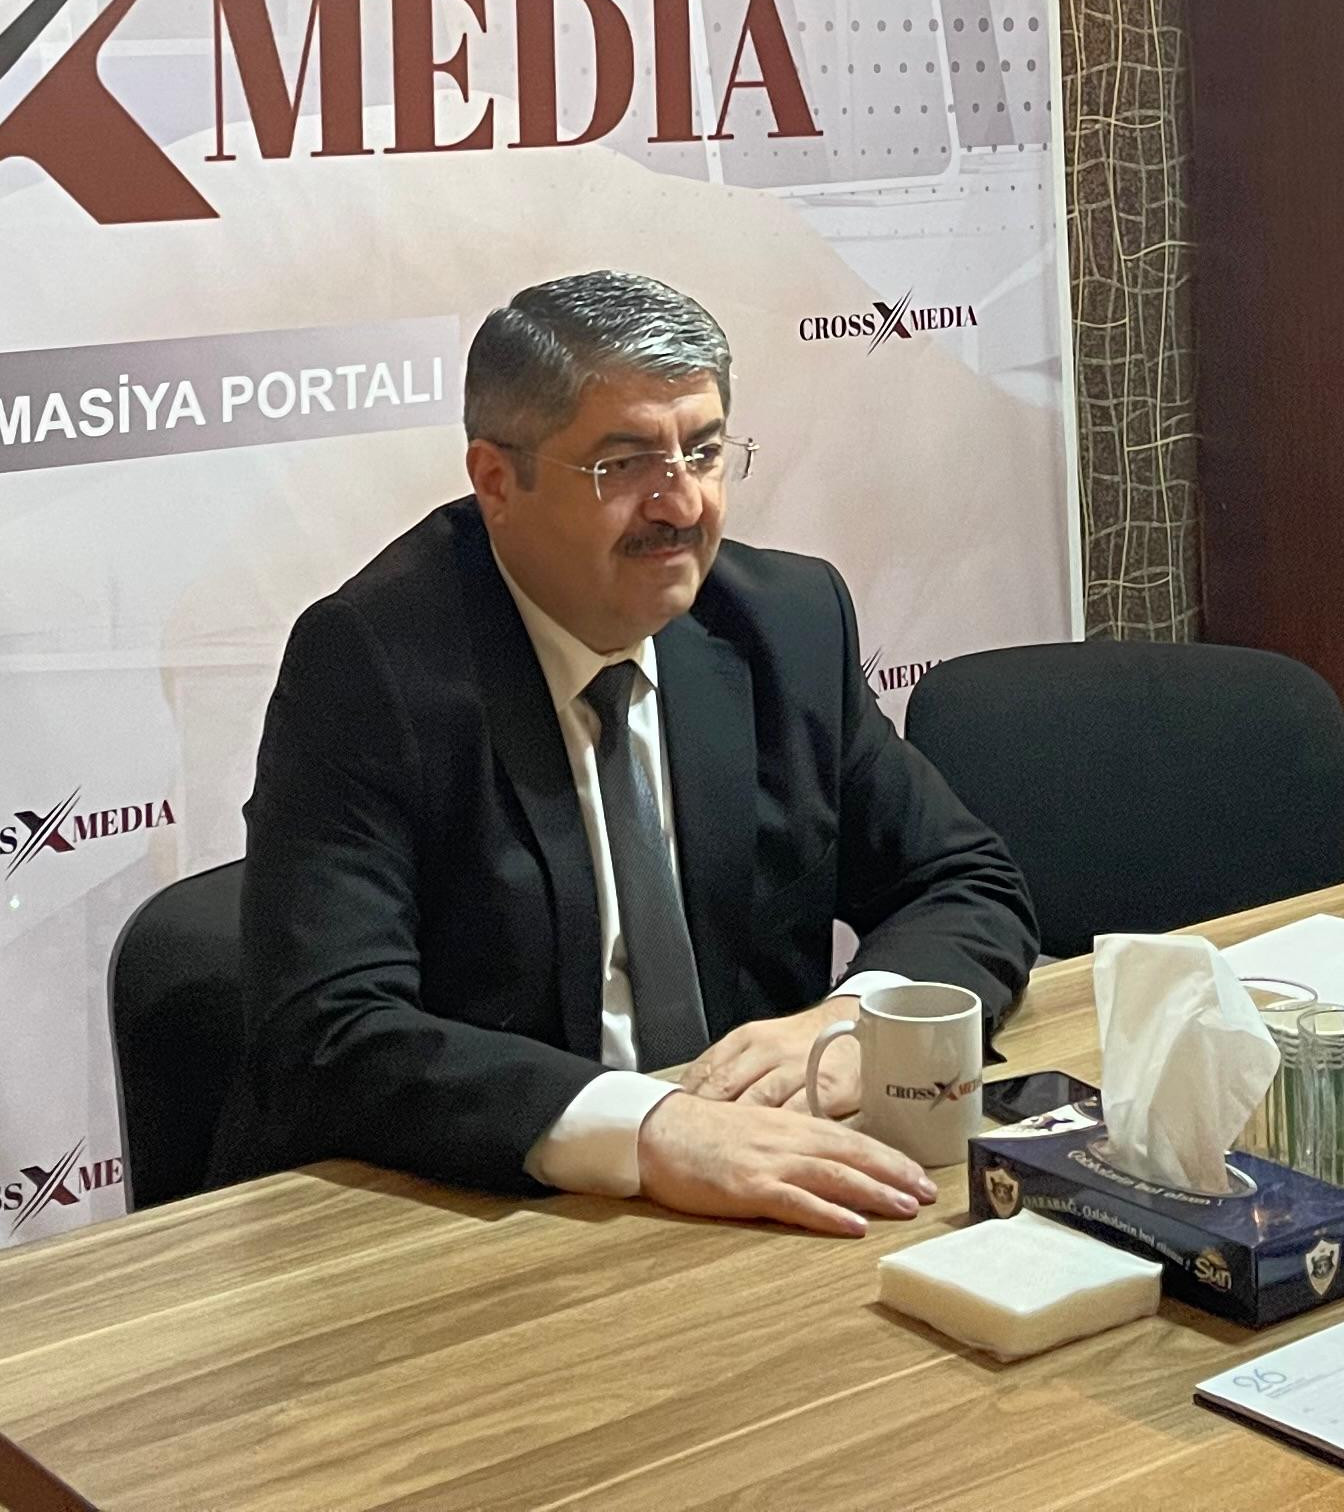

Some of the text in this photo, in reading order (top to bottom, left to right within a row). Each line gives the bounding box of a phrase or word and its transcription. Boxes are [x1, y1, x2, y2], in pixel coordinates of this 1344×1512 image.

[221, 358, 444, 421] PORTALI
[878, 660, 943, 692] MED
[1194, 1257, 1233, 1293] Sun
